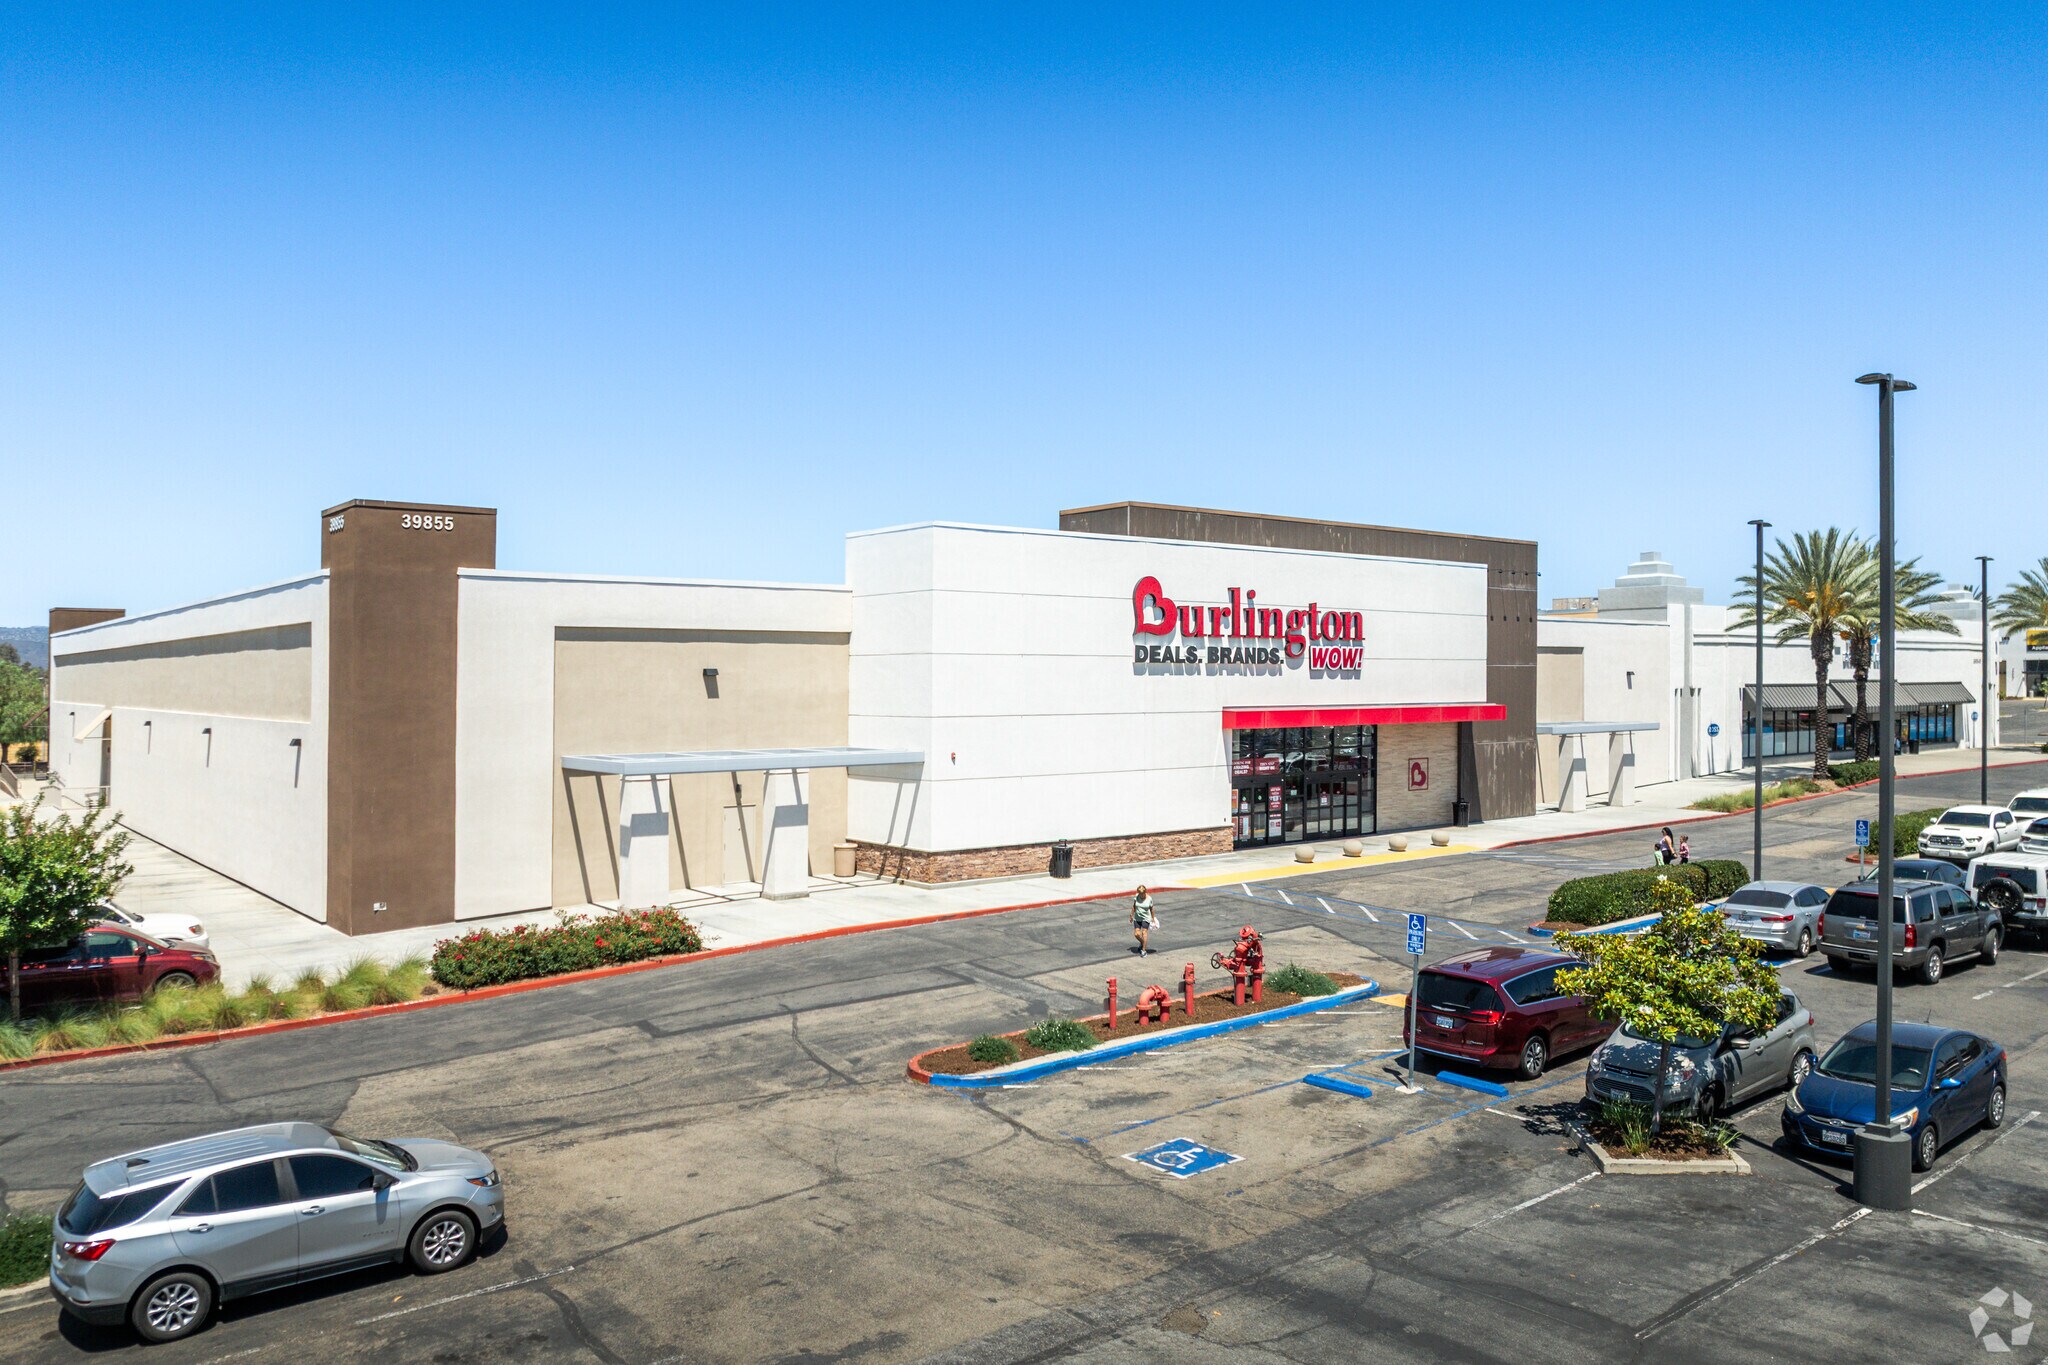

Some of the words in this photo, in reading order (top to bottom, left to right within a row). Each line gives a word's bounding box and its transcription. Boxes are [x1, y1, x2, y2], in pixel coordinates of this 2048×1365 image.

[402, 513, 454, 531] 39855
[1132, 575, 1366, 658] Burlington
[1134, 644, 1203, 664] DEALS.
[1207, 646, 1284, 665] BRANDS.
[1309, 646, 1364, 671] WOW!
